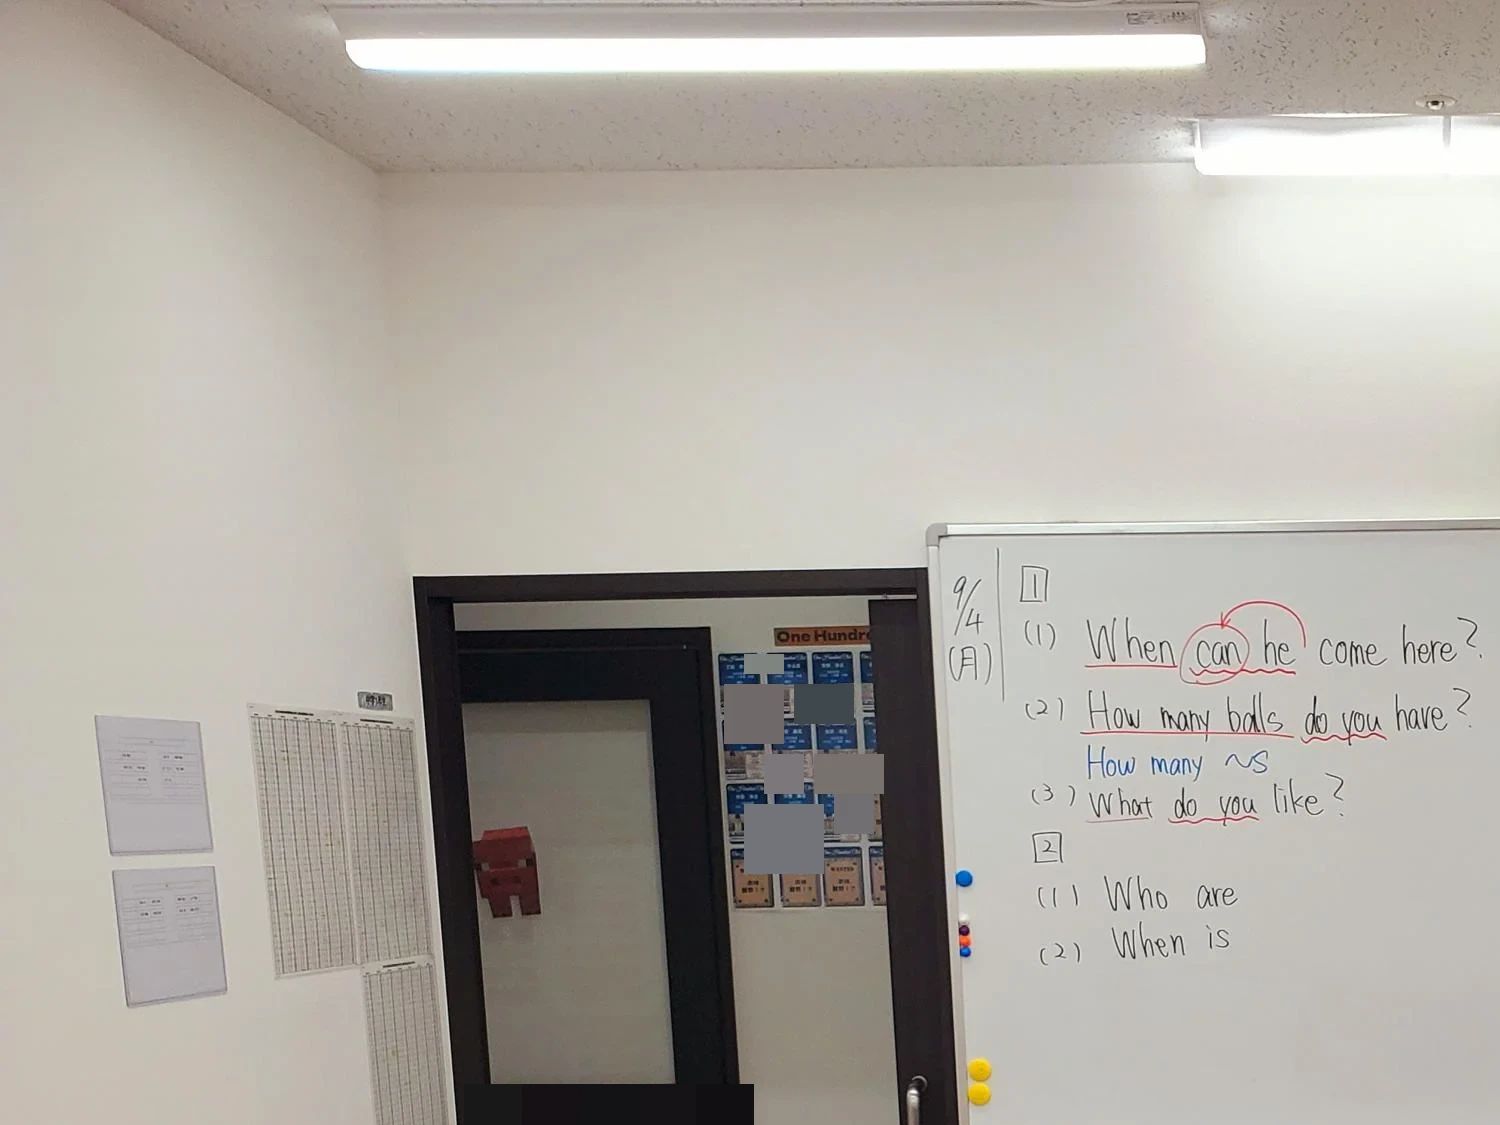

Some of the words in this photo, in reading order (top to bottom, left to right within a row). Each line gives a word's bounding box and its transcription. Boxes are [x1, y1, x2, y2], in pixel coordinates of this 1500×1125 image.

[777, 631, 811, 643] One
[1087, 617, 1175, 663] When
[1197, 640, 1241, 668] can
[1263, 618, 1296, 665] he
[1320, 639, 1387, 667] come
[1089, 690, 1140, 732] How
[1160, 706, 1210, 741] many
[1226, 692, 1283, 734] balls
[1305, 696, 1327, 735] do
[1340, 710, 1382, 747] you
[1088, 745, 1135, 779] How
[1151, 758, 1202, 787] many
[1089, 788, 1152, 818] What
[1175, 787, 1197, 819] do
[1219, 796, 1258, 827] you
[1104, 875, 1167, 911] Who
[1198, 885, 1238, 909] are
[1112, 925, 1185, 959] When
[1206, 925, 1229, 949] is
